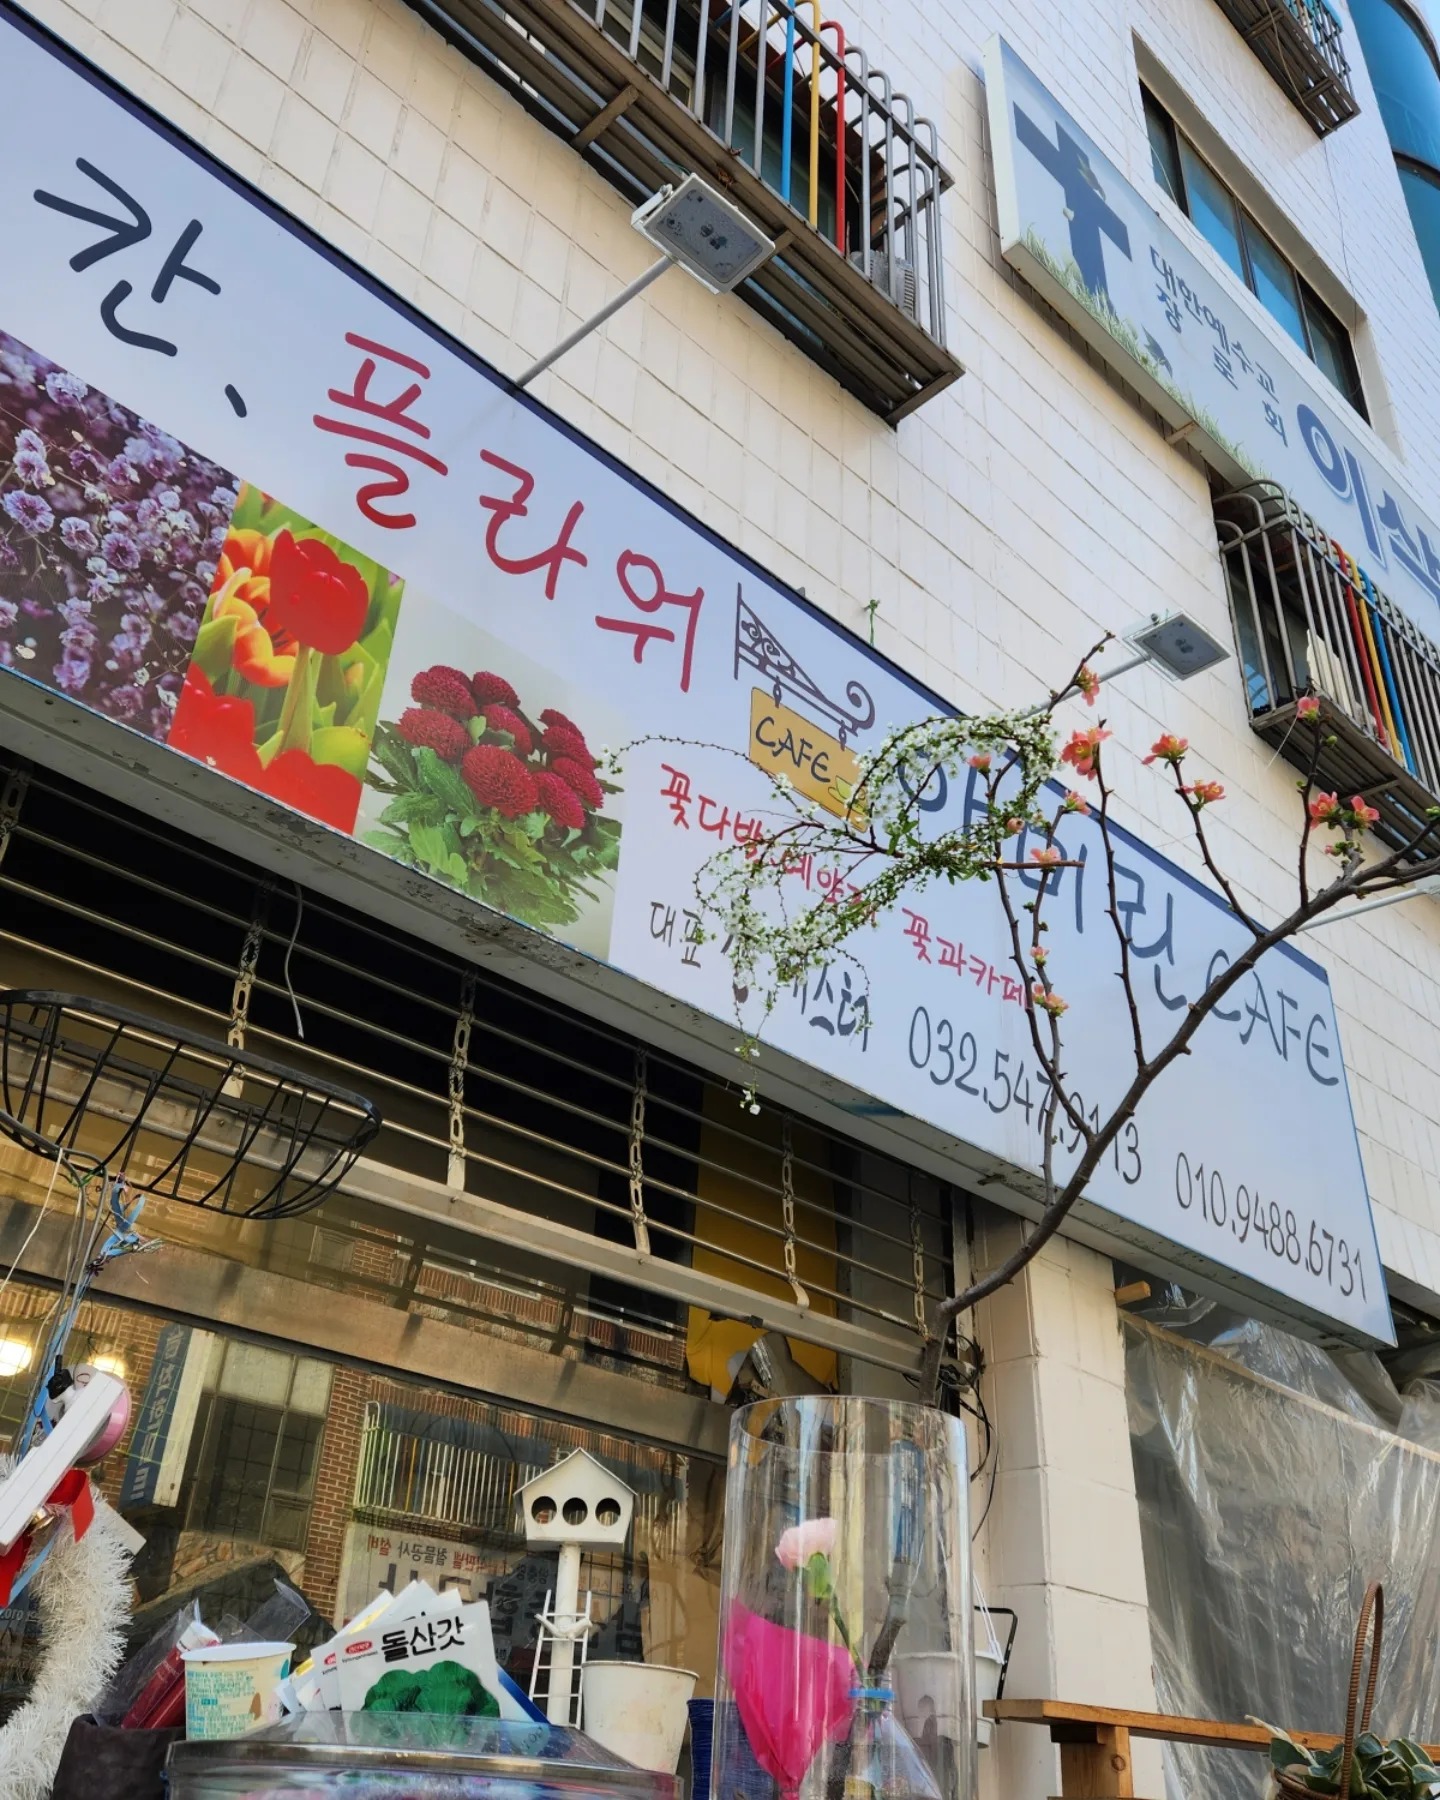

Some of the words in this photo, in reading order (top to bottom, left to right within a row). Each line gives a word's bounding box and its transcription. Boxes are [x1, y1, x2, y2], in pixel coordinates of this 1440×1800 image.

[1149, 245, 1280, 404] 대한예수교
[1156, 284, 1289, 448] 장로회
[313, 331, 705, 692] 플라워
[754, 715, 832, 783] CAFE
[650, 901, 704, 969] 대표
[1205, 948, 1340, 1086] CAFE
[381, 1615, 465, 1663] 돌산갓
